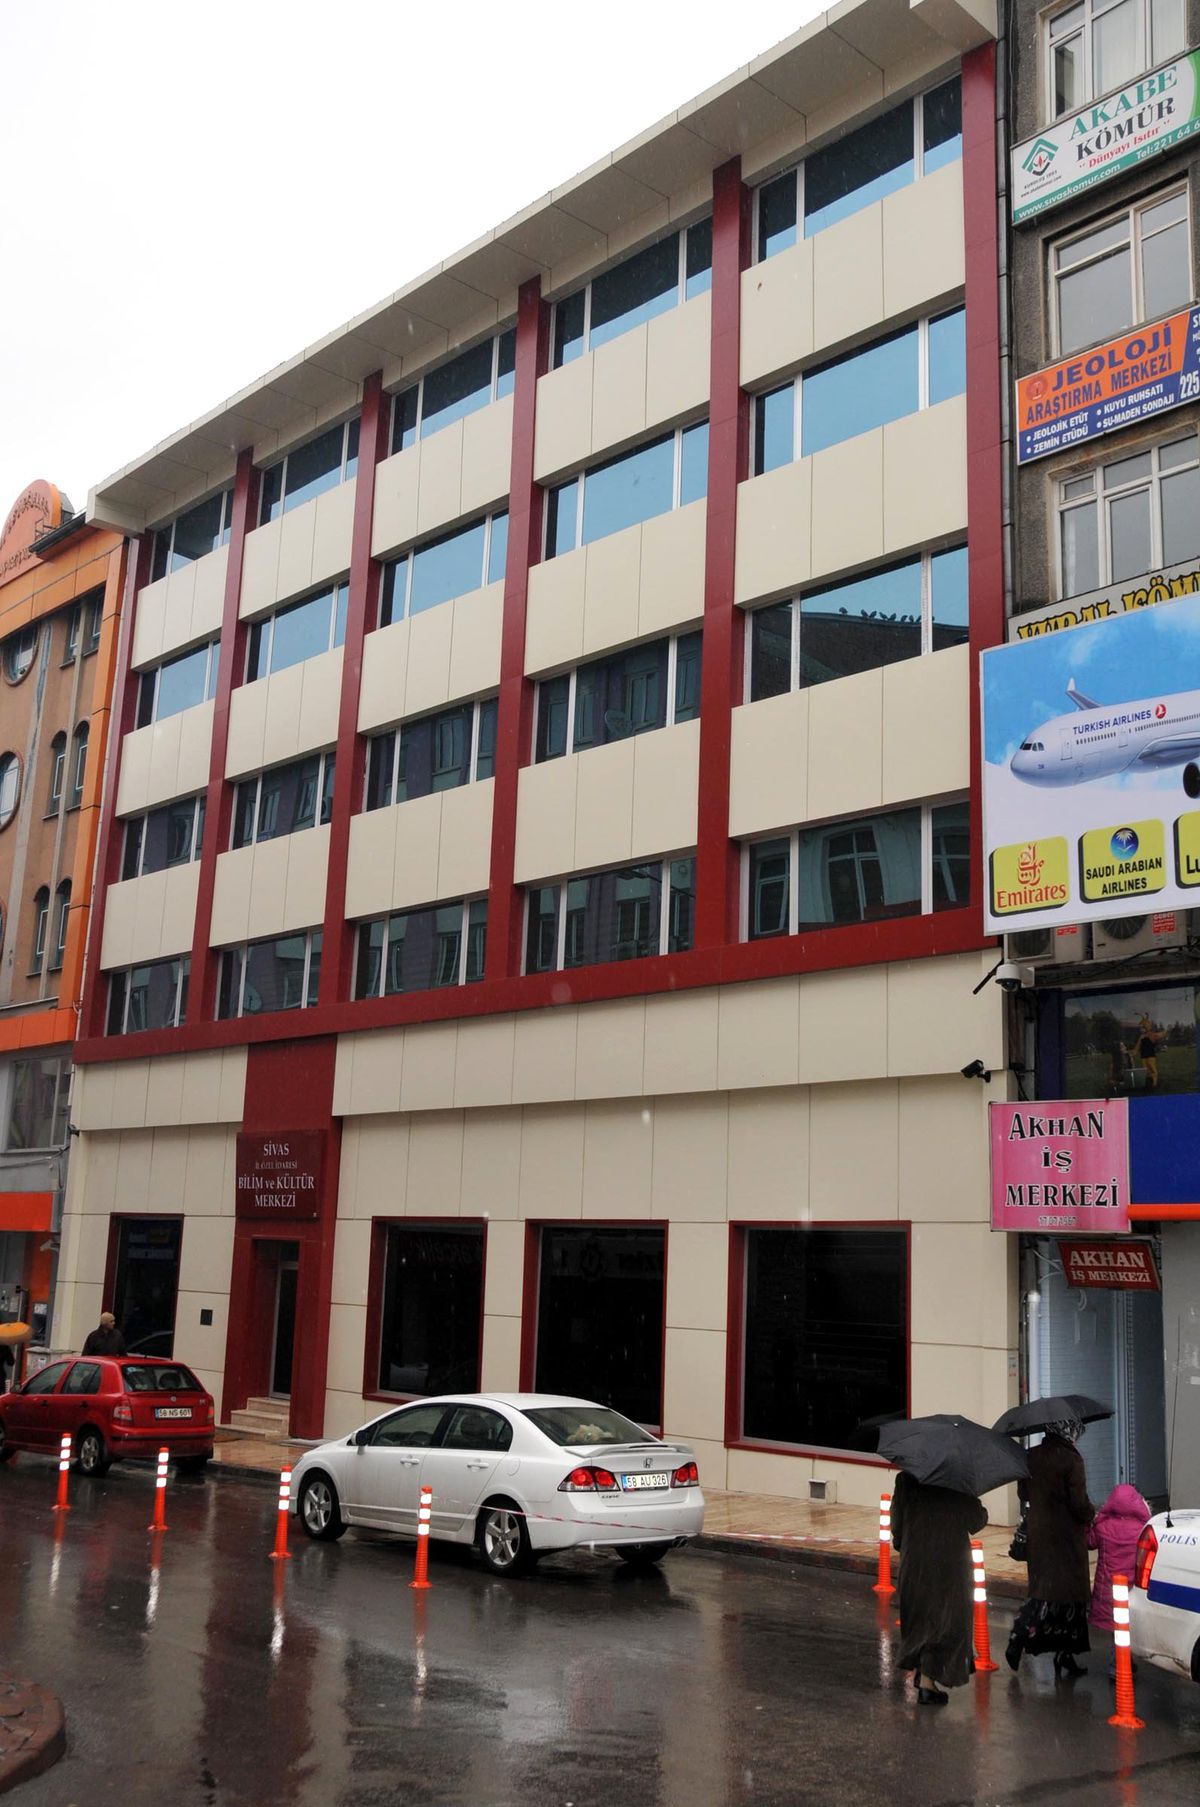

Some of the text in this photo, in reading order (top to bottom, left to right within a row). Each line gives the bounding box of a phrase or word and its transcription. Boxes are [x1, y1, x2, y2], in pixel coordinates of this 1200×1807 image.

[1069, 65, 1178, 140] AKABE
[1076, 97, 1176, 161] KÖMÜR
[1052, 322, 1172, 391] JEOLOJİ
[1026, 348, 1172, 425] ARAŞTIRMA MERKEZİ
[1180, 370, 1200, 399] 225
[1104, 383, 1163, 415] KUYU RUHSATI
[1142, 393, 1174, 415] SONDAJI
[1070, 411, 1089, 428] ETÜT
[1033, 424, 1089, 454] ZEMİN ETÜDÜ
[1073, 710, 1152, 735] TURKISH AIRLINES
[1085, 857, 1162, 881] SAUDI ARABIAN
[996, 883, 1067, 909] Emirates
[1101, 877, 1147, 896] AIRLINES
[1008, 1111, 1105, 1140] AKHAN
[263, 1140, 290, 1156] SİVAS
[1041, 1146, 1073, 1173] İŞ
[238, 1172, 314, 1189] BİLİM ve KÜLTÜR
[1005, 1178, 1120, 1208] MERKEZİ
[255, 1191, 296, 1207] MERKEZİ
[1069, 1250, 1146, 1268] AKHAN
[1070, 1268, 1152, 1284] İŞ MERKEZİ
[627, 1476, 637, 1488] 58
[640, 1475, 652, 1487] AU
